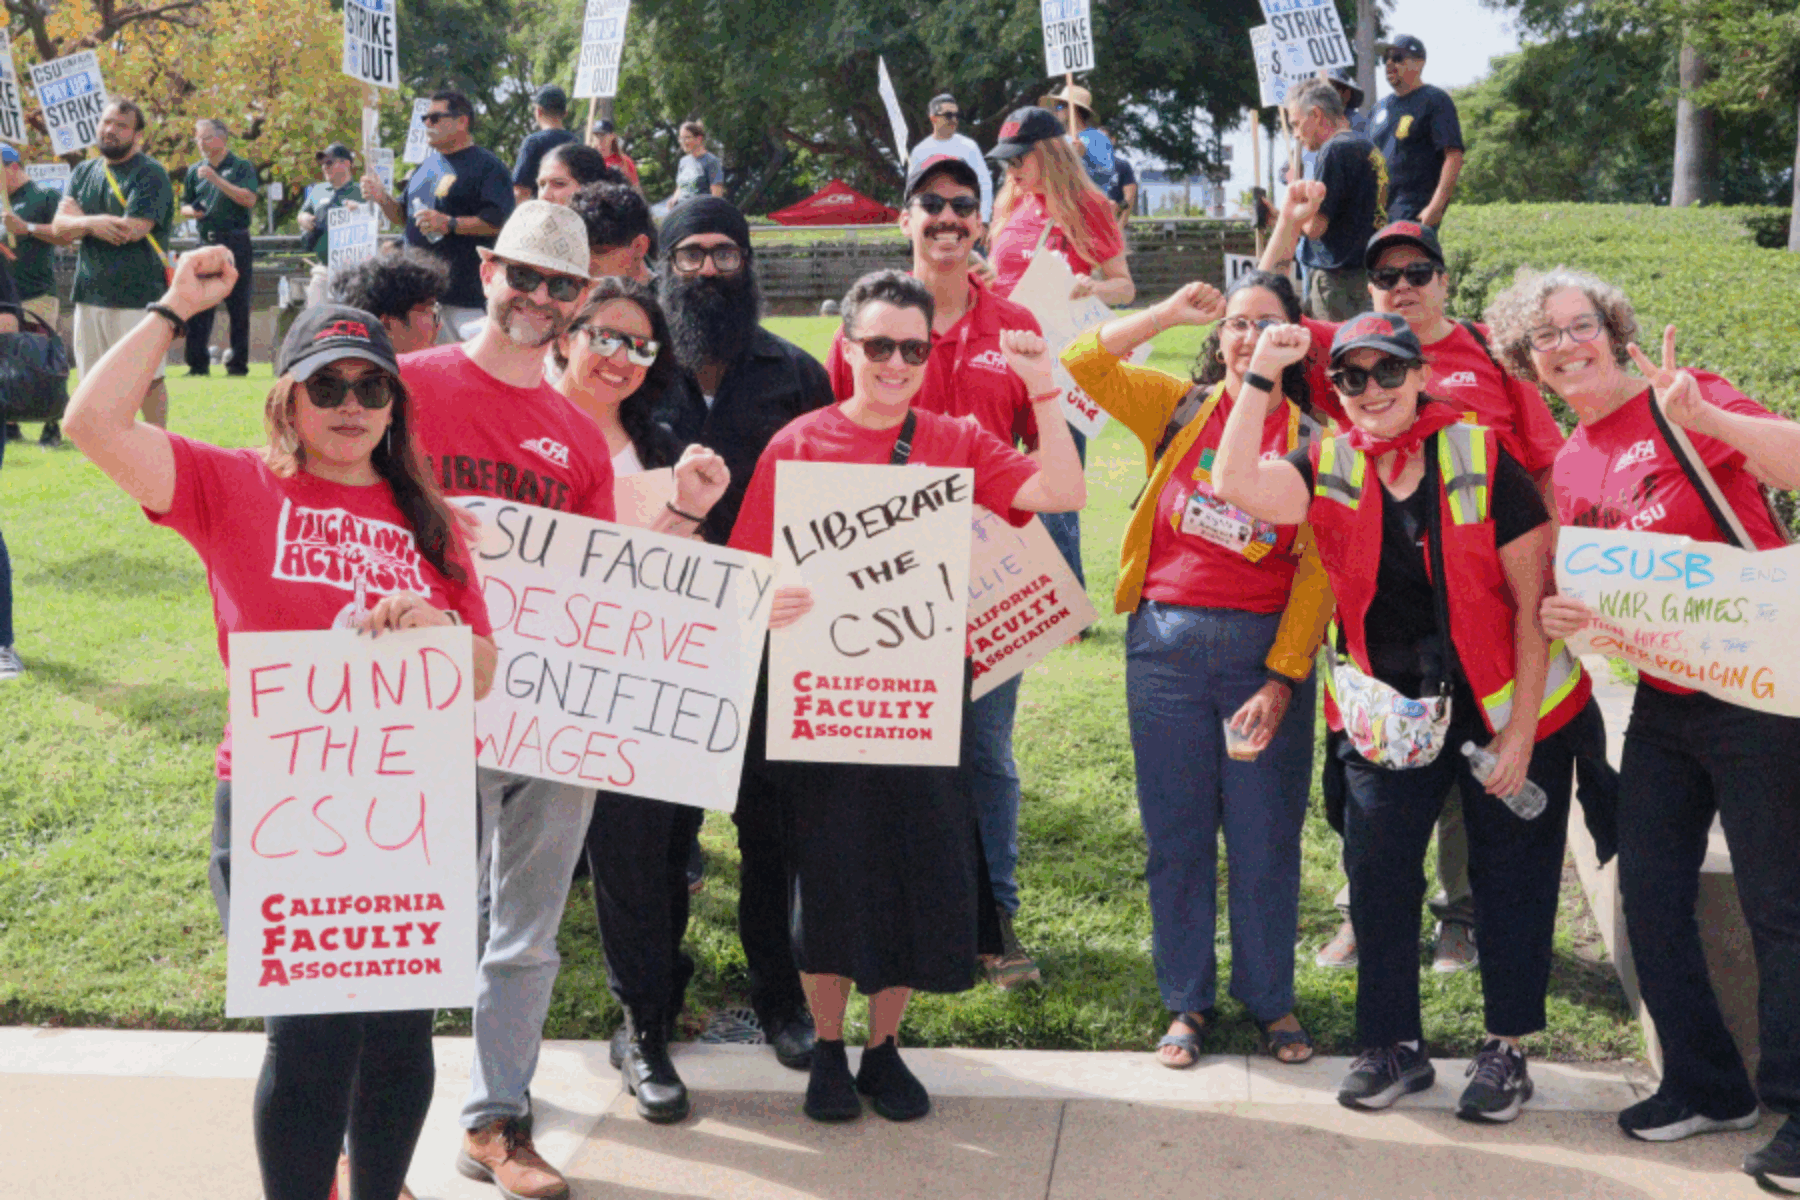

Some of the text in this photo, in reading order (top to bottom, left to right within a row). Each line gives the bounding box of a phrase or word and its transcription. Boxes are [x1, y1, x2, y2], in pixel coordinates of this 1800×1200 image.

[346, 2, 393, 47] STRIKE
[1046, 17, 1087, 46] STRIKE
[1271, 7, 1339, 42] STRIKE
[361, 44, 393, 84] OUT
[1063, 41, 1089, 69] OUT
[1307, 34, 1347, 66] OUT
[33, 63, 63, 84] CSU
[592, 67, 616, 93] OUT
[0, 110, 20, 139] UT
[46, 91, 105, 128] STRIKE
[75, 116, 100, 144] OU
[333, 320, 369, 340] CFA
[1451, 371, 1476, 384] CFA
[537, 437, 569, 464] CFA
[1628, 439, 1657, 459] CFA
[428, 455, 570, 511] IBERATE
[782, 473, 969, 566] LIBERATE
[1631, 503, 1667, 531] CSU
[464, 501, 772, 621] SU FACULTY
[847, 549, 920, 591] THE
[1565, 543, 1788, 590] CSUSB END
[966, 573, 1053, 634] ALIFORNIA
[1599, 589, 1653, 623] WAR
[481, 575, 718, 669] DESERVE
[250, 647, 462, 718] FUND
[793, 670, 938, 694] CALIFORNIA
[504, 647, 741, 753] GNIFIED
[793, 694, 935, 719] FACULTY
[790, 719, 933, 741] ASSOCIATION
[268, 725, 415, 777] THE
[478, 710, 641, 787] WAGES
[250, 791, 431, 866] CSU
[260, 892, 446, 923] CALIFORNIA
[261, 921, 442, 956] FACULTY
[258, 957, 443, 987] ASSOCIATION
